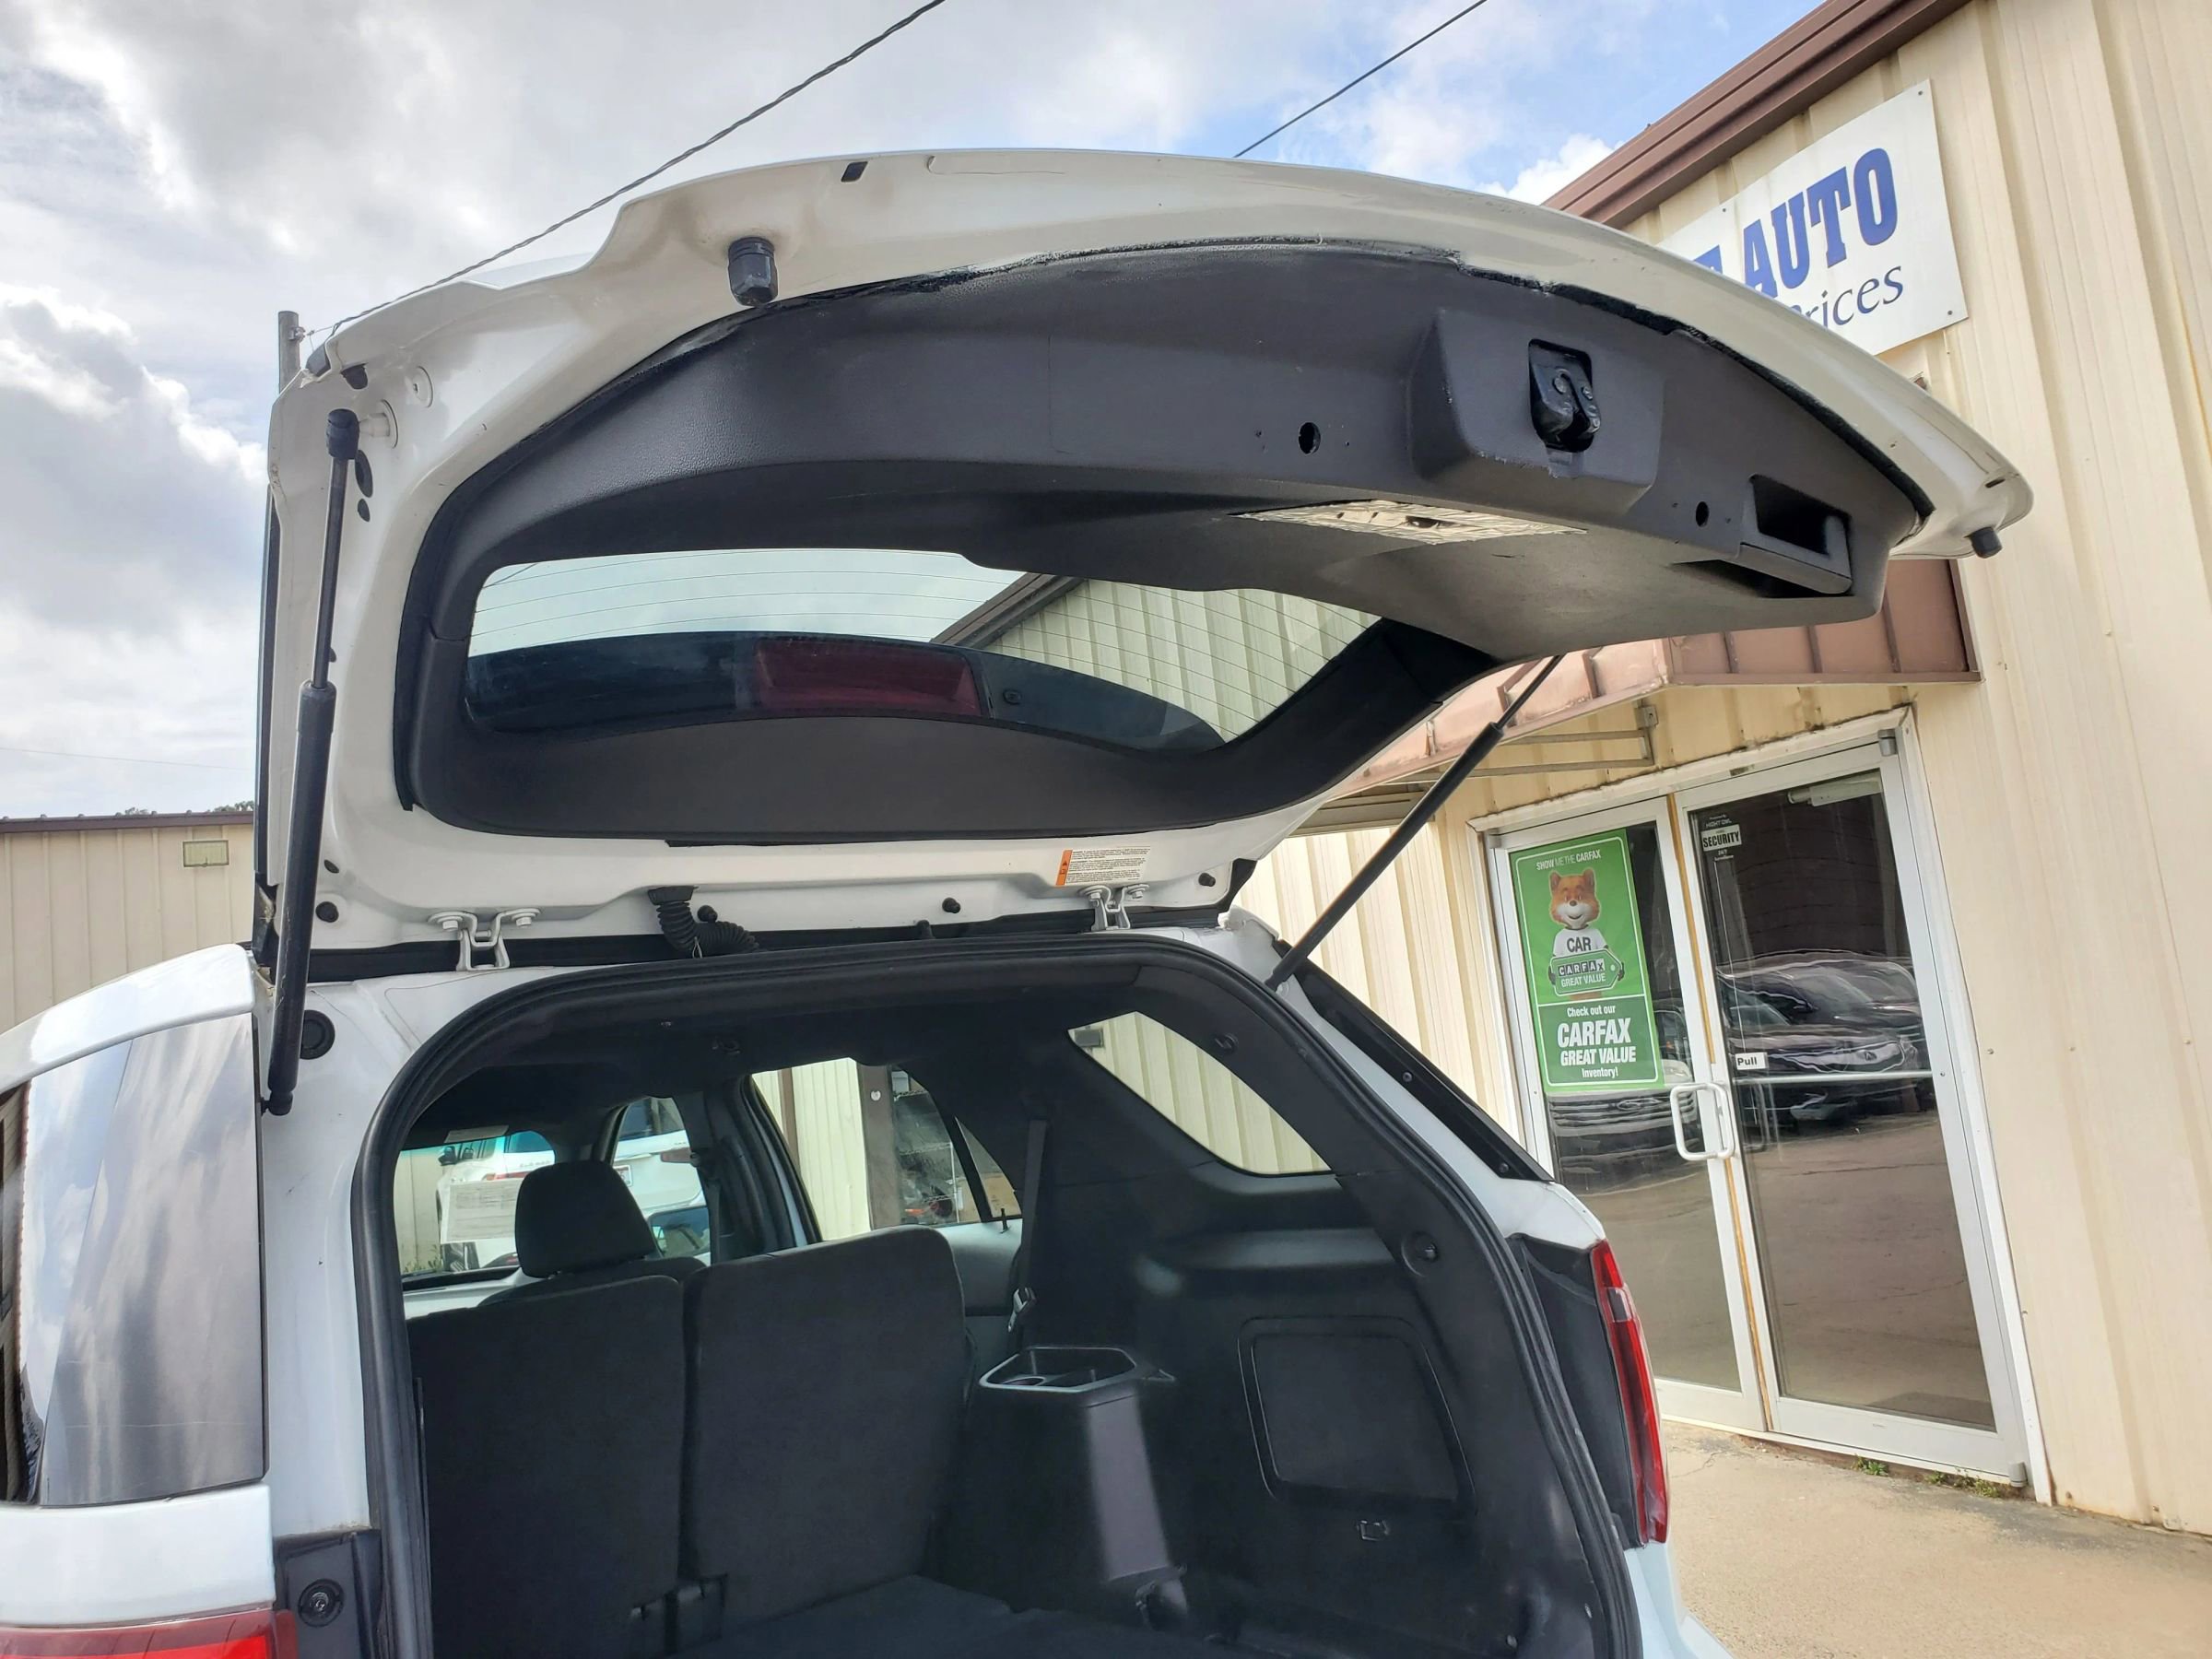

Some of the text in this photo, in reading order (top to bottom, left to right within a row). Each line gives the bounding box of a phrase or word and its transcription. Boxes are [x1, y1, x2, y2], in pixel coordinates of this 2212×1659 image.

[1743, 147, 1898, 300] AUTO
[1702, 830, 1739, 848] SECURITY
[1536, 849, 1601, 871] SHOW ME THE CARFAX
[1566, 936, 1592, 953] CAR
[1559, 960, 1605, 975] CARFAX
[1560, 973, 1606, 988] GREAT VALUE
[1567, 1005, 1617, 1018] Check out our
[1557, 1017, 1631, 1048] CARFAX
[1560, 1046, 1637, 1066] GREAT VALUE
[1737, 1056, 1757, 1065] Pull
[1582, 1066, 1619, 1079] Inventory!
